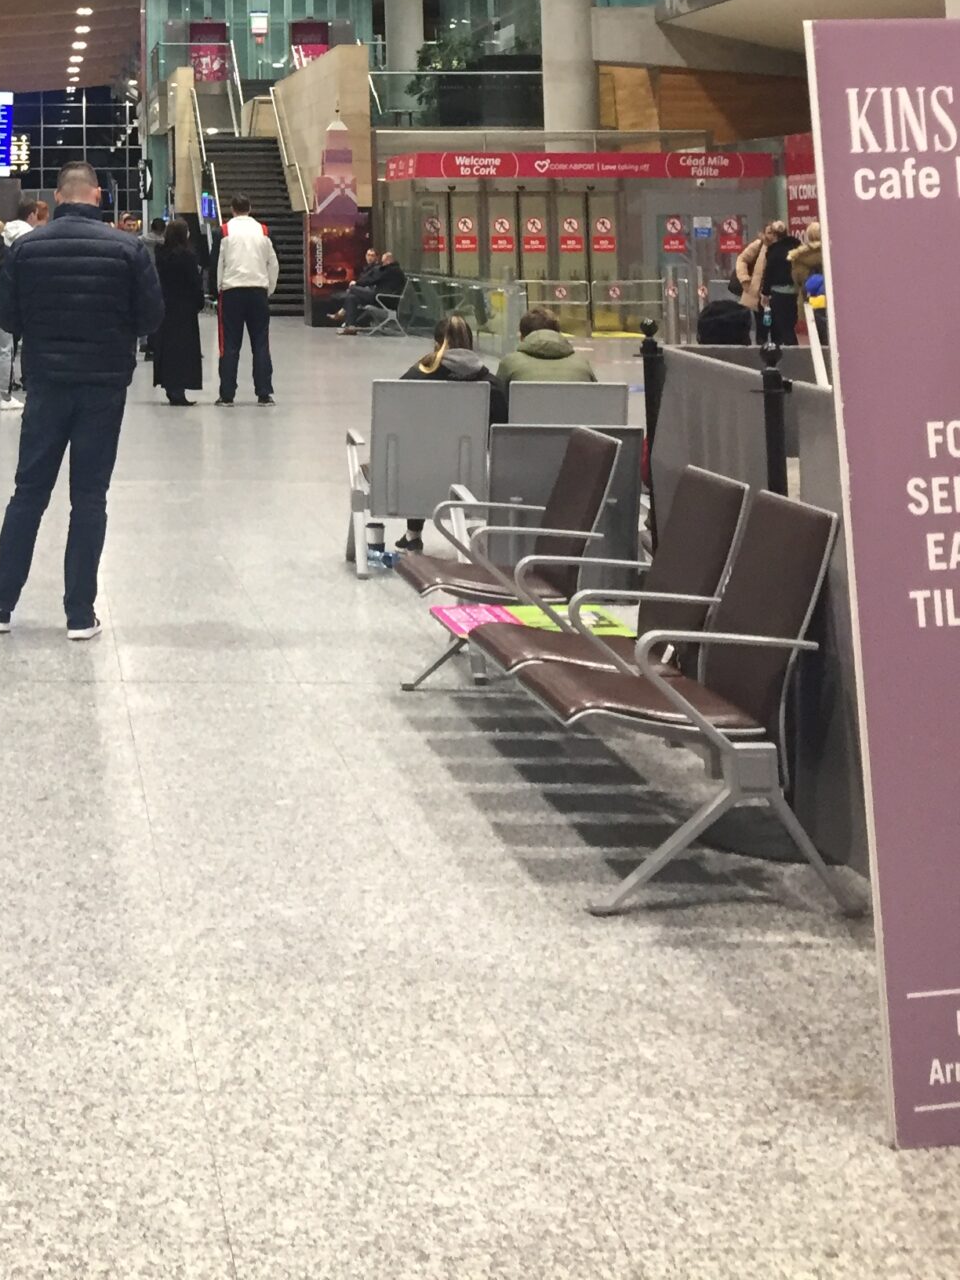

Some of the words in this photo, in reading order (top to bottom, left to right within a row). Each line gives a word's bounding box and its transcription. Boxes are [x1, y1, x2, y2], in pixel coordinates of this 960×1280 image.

[845, 86, 958, 153] KINS
[455, 156, 501, 166] Welcome
[460, 167, 471, 176] to
[473, 166, 497, 176] Cork
[854, 157, 941, 200] cafe
